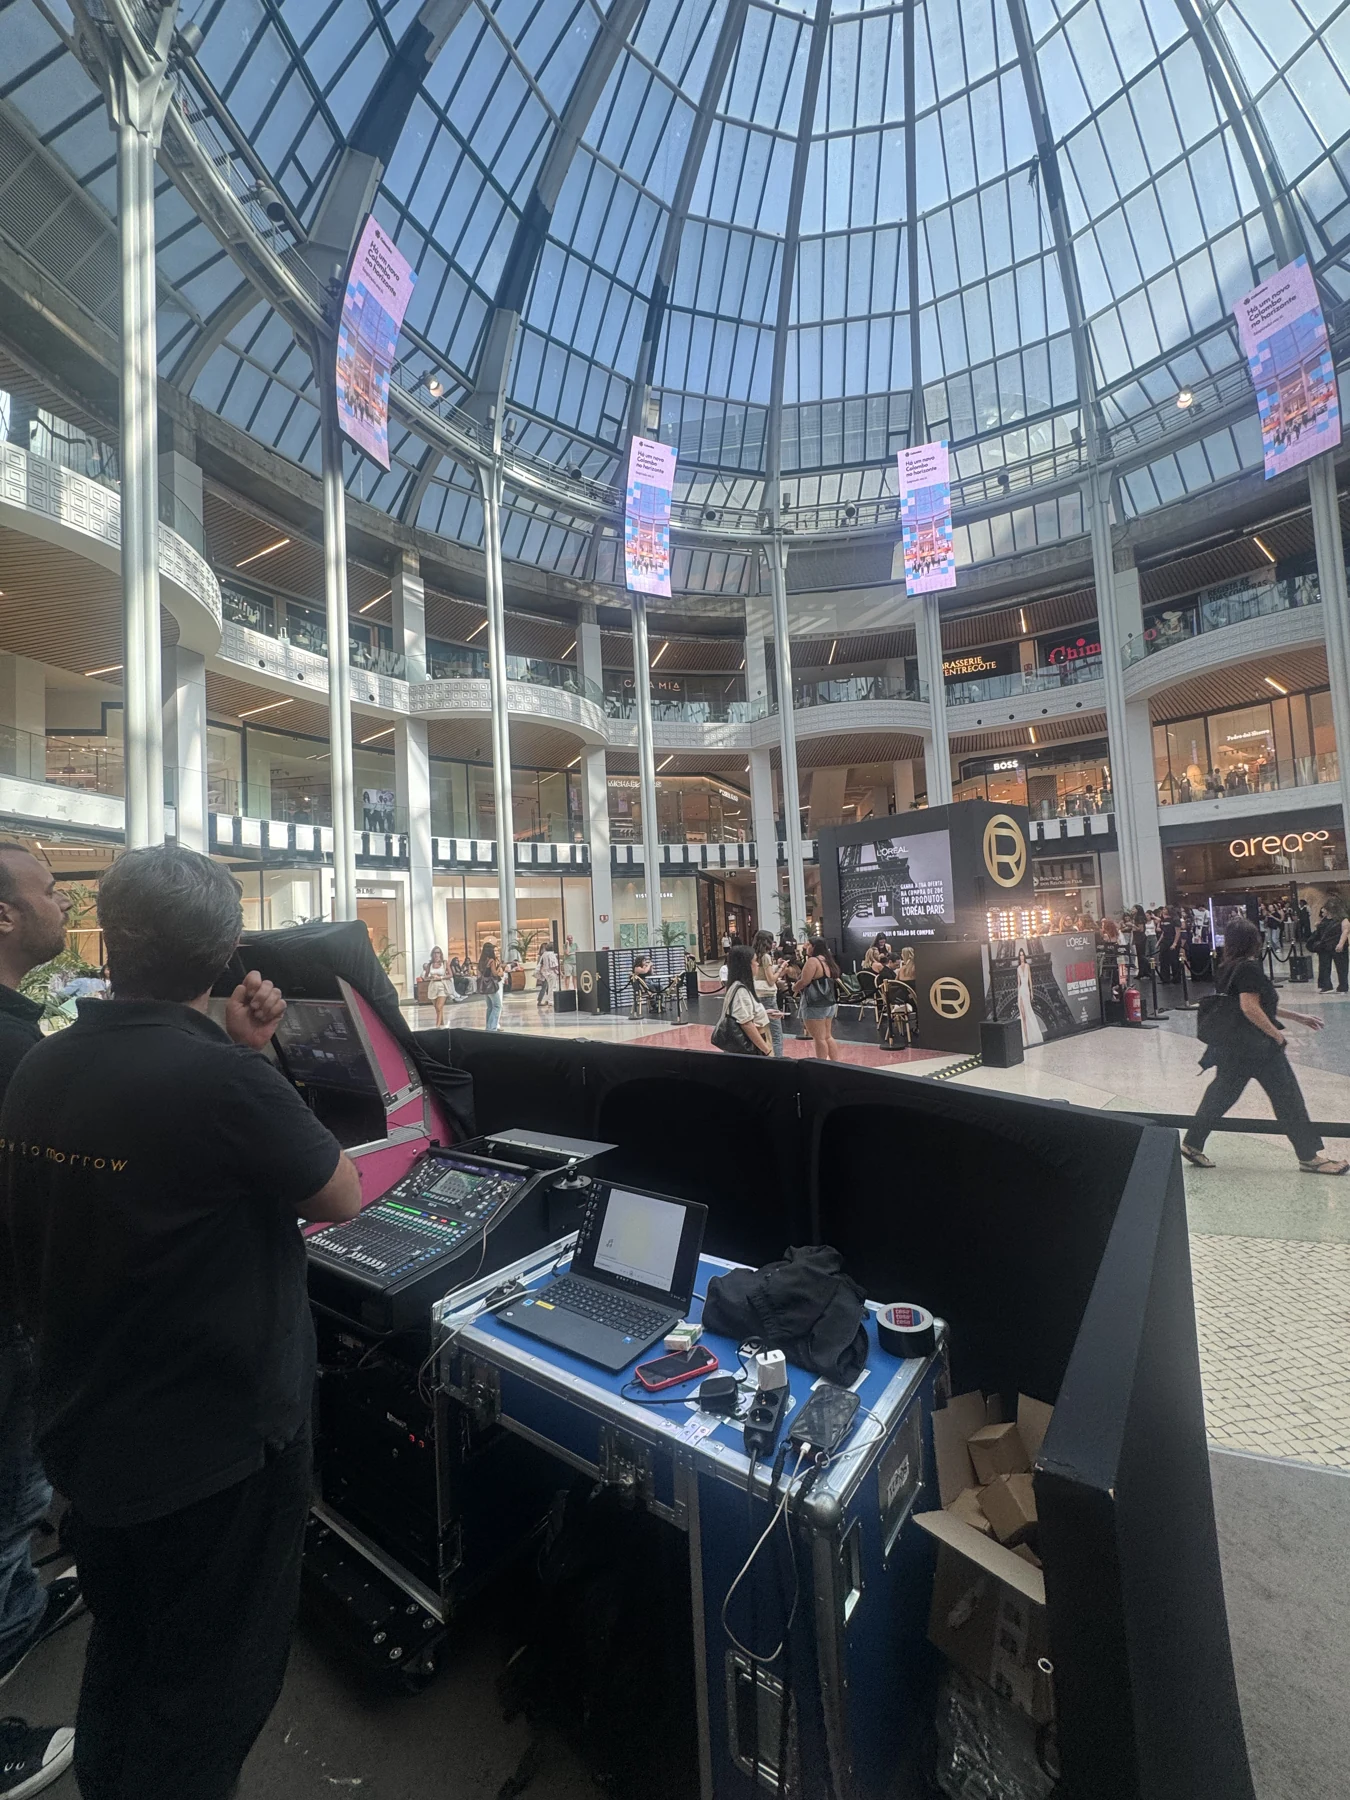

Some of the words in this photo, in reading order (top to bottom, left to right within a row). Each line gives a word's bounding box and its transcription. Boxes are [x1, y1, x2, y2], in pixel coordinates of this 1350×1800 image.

[368, 249, 390, 280] Colombo
[370, 241, 379, 255] Há
[378, 253, 388, 266] um
[387, 263, 400, 281] novo
[365, 257, 372, 268] no
[372, 264, 396, 297] horizonte
[1246, 305, 1258, 316] Há
[1258, 298, 1271, 308] um
[1272, 284, 1291, 300] novo
[1249, 297, 1282, 322] Colombo
[1250, 319, 1261, 329] no
[1261, 295, 1297, 322] horizonte
[636, 456, 658, 466] Colombo
[642, 464, 664, 474] horizonte
[906, 463, 928, 472] Colombo
[914, 466, 937, 476] horizonte
[624, 679, 654, 689] CA
[993, 760, 1018, 771] BOSS
[901, 896, 910, 905] EM
[912, 894, 944, 904] PRODUTOS
[902, 905, 926, 916] L'ORÉAL
[926, 904, 944, 915] PARIS
